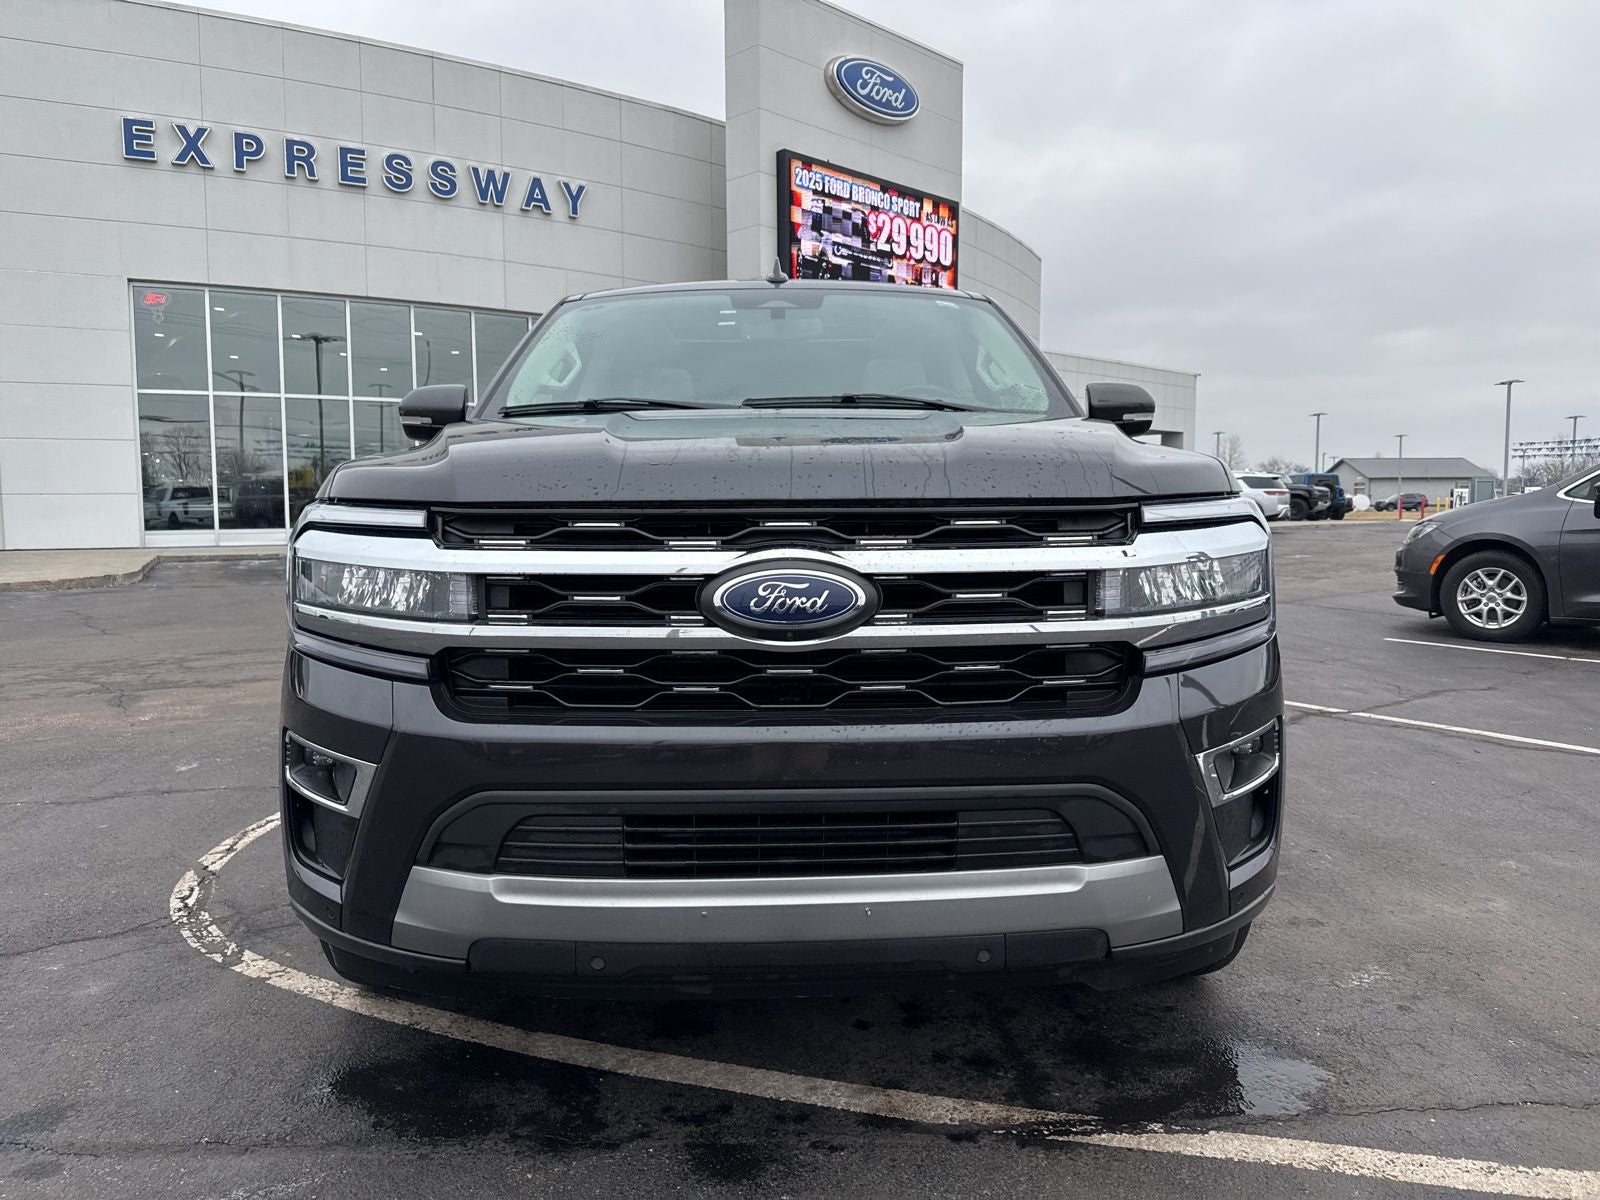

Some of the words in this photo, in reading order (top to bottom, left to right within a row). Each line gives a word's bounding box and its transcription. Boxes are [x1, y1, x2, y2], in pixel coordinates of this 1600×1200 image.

[856, 66, 906, 109] Ford
[120, 115, 588, 219] EXPRESSWAY
[795, 166, 823, 191] 2025
[824, 175, 850, 199] FORD
[852, 183, 891, 210] BRONCO
[892, 195, 920, 218] SPORT
[750, 581, 830, 614] Ford
